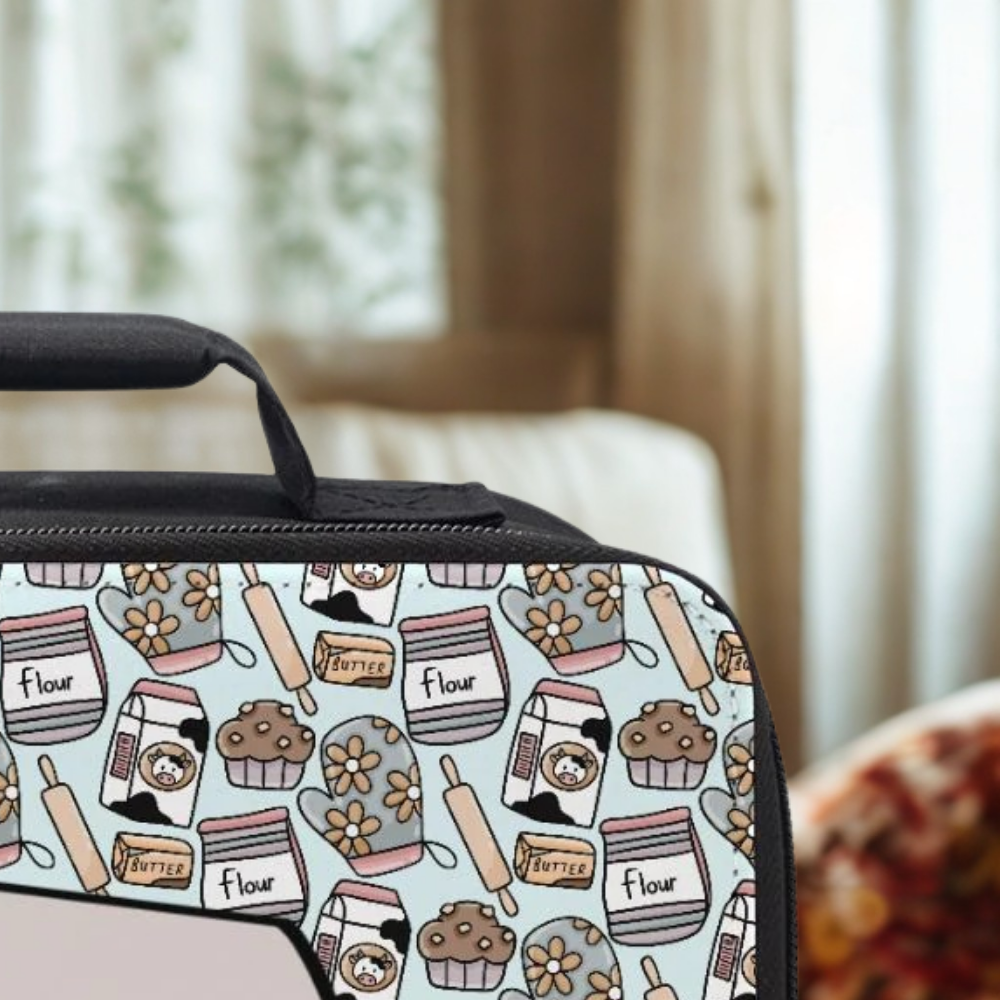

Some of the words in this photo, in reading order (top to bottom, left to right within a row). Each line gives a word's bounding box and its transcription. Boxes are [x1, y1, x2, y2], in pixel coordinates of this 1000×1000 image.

[331, 656, 386, 676] BUTTER
[17, 667, 74, 699] flour
[419, 667, 476, 699] flour
[130, 857, 185, 877] BUTTER
[532, 857, 587, 877] BUTTER
[218, 868, 275, 900] flour
[620, 868, 677, 900] flour
